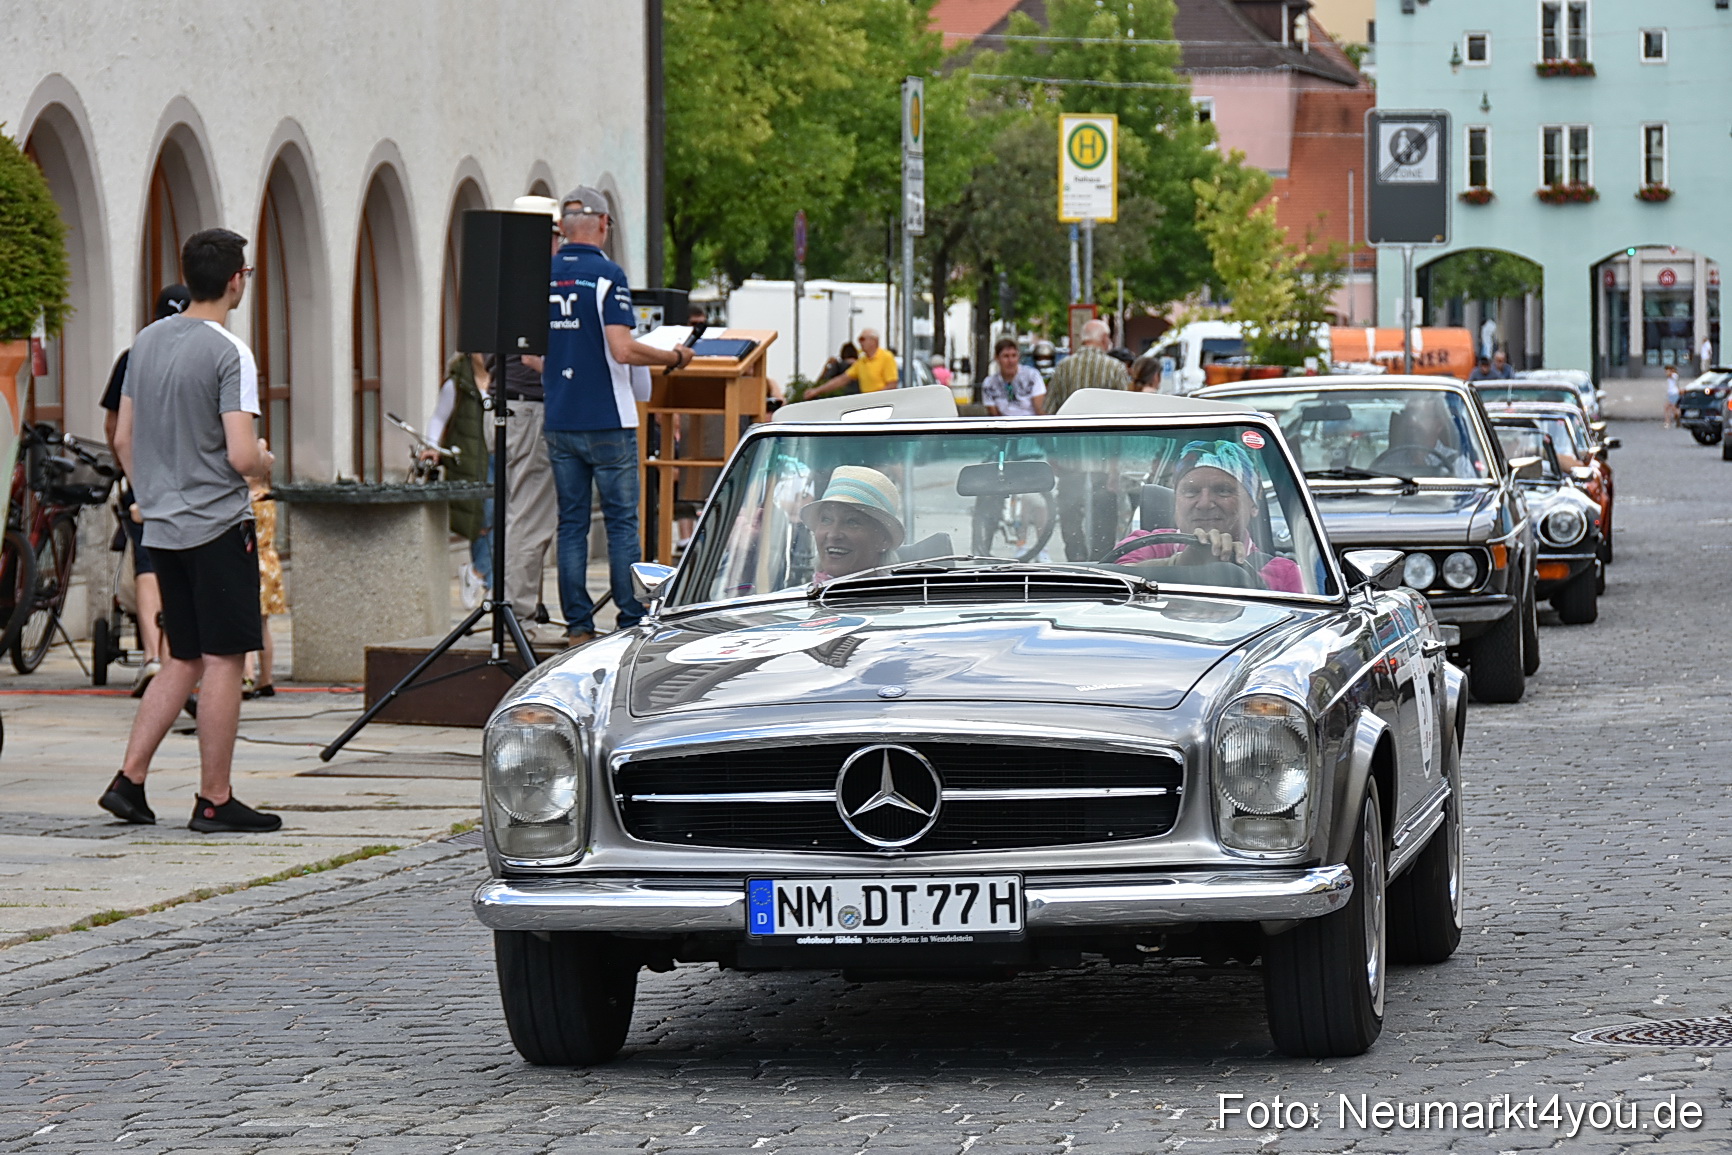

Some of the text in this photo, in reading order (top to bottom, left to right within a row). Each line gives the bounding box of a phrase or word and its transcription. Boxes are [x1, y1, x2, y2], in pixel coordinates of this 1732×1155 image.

[1080, 134, 1096, 159] H
[777, 882, 1017, 928] NM DT 77H
[757, 913, 768, 926] D
[866, 936, 919, 944] Mercedes-Benz
[920, 935, 928, 943] in
[930, 935, 973, 943] Wendelstein
